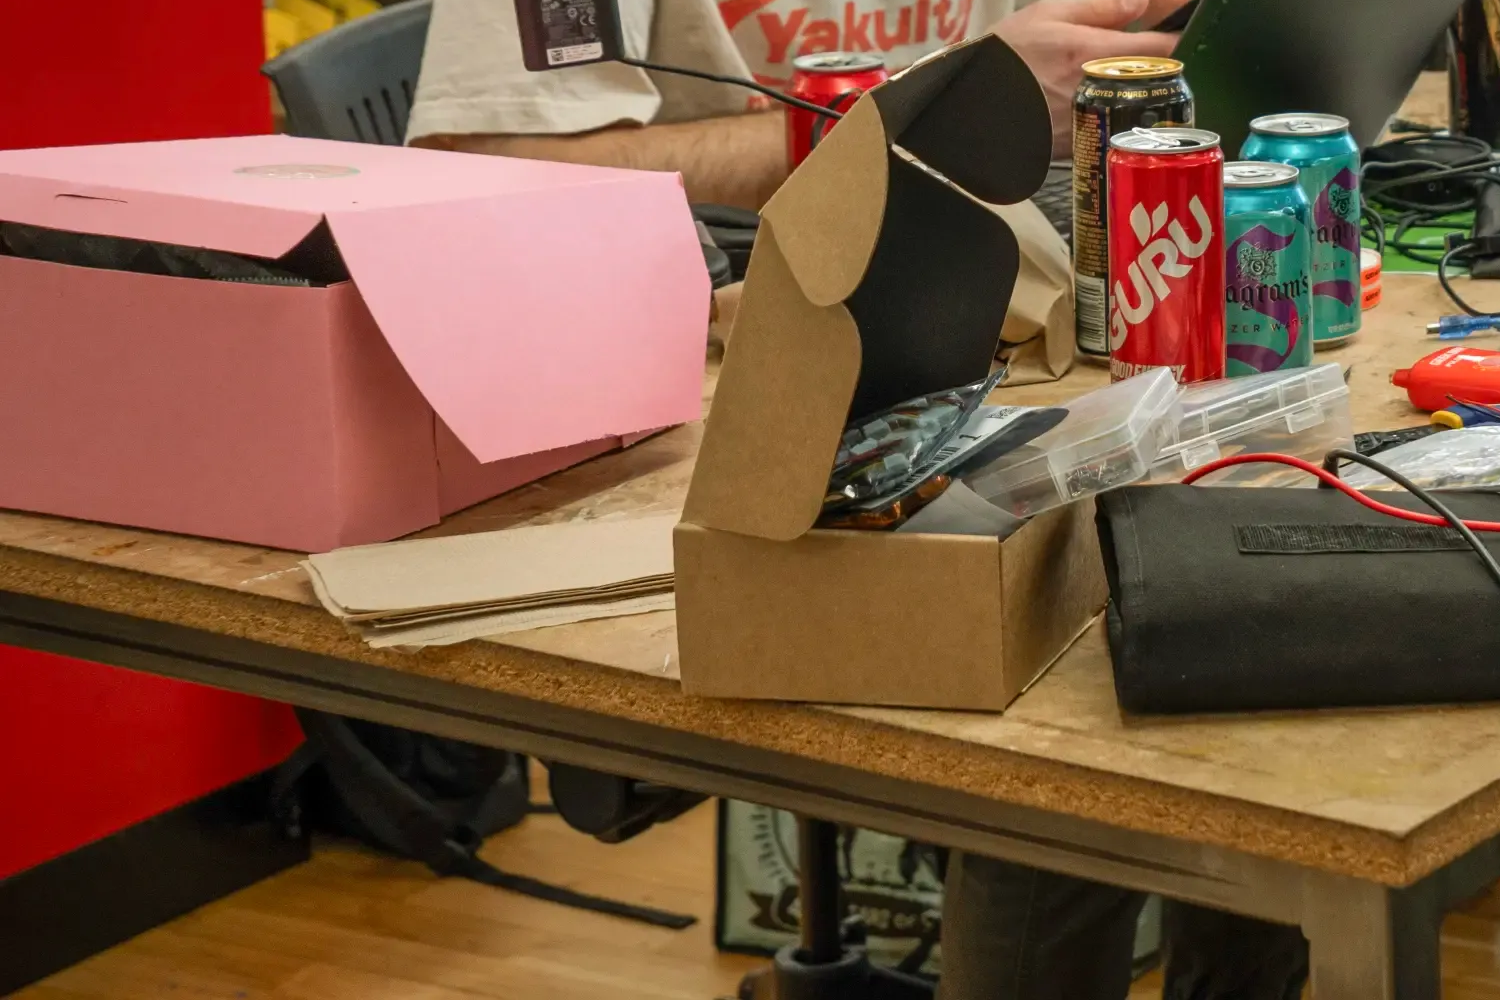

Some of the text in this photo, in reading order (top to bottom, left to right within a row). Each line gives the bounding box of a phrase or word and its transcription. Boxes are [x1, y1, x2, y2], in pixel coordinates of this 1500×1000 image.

[1152, 88, 1168, 97] INTO
[1110, 194, 1213, 351] GURU
[1226, 270, 1309, 311] agram's
